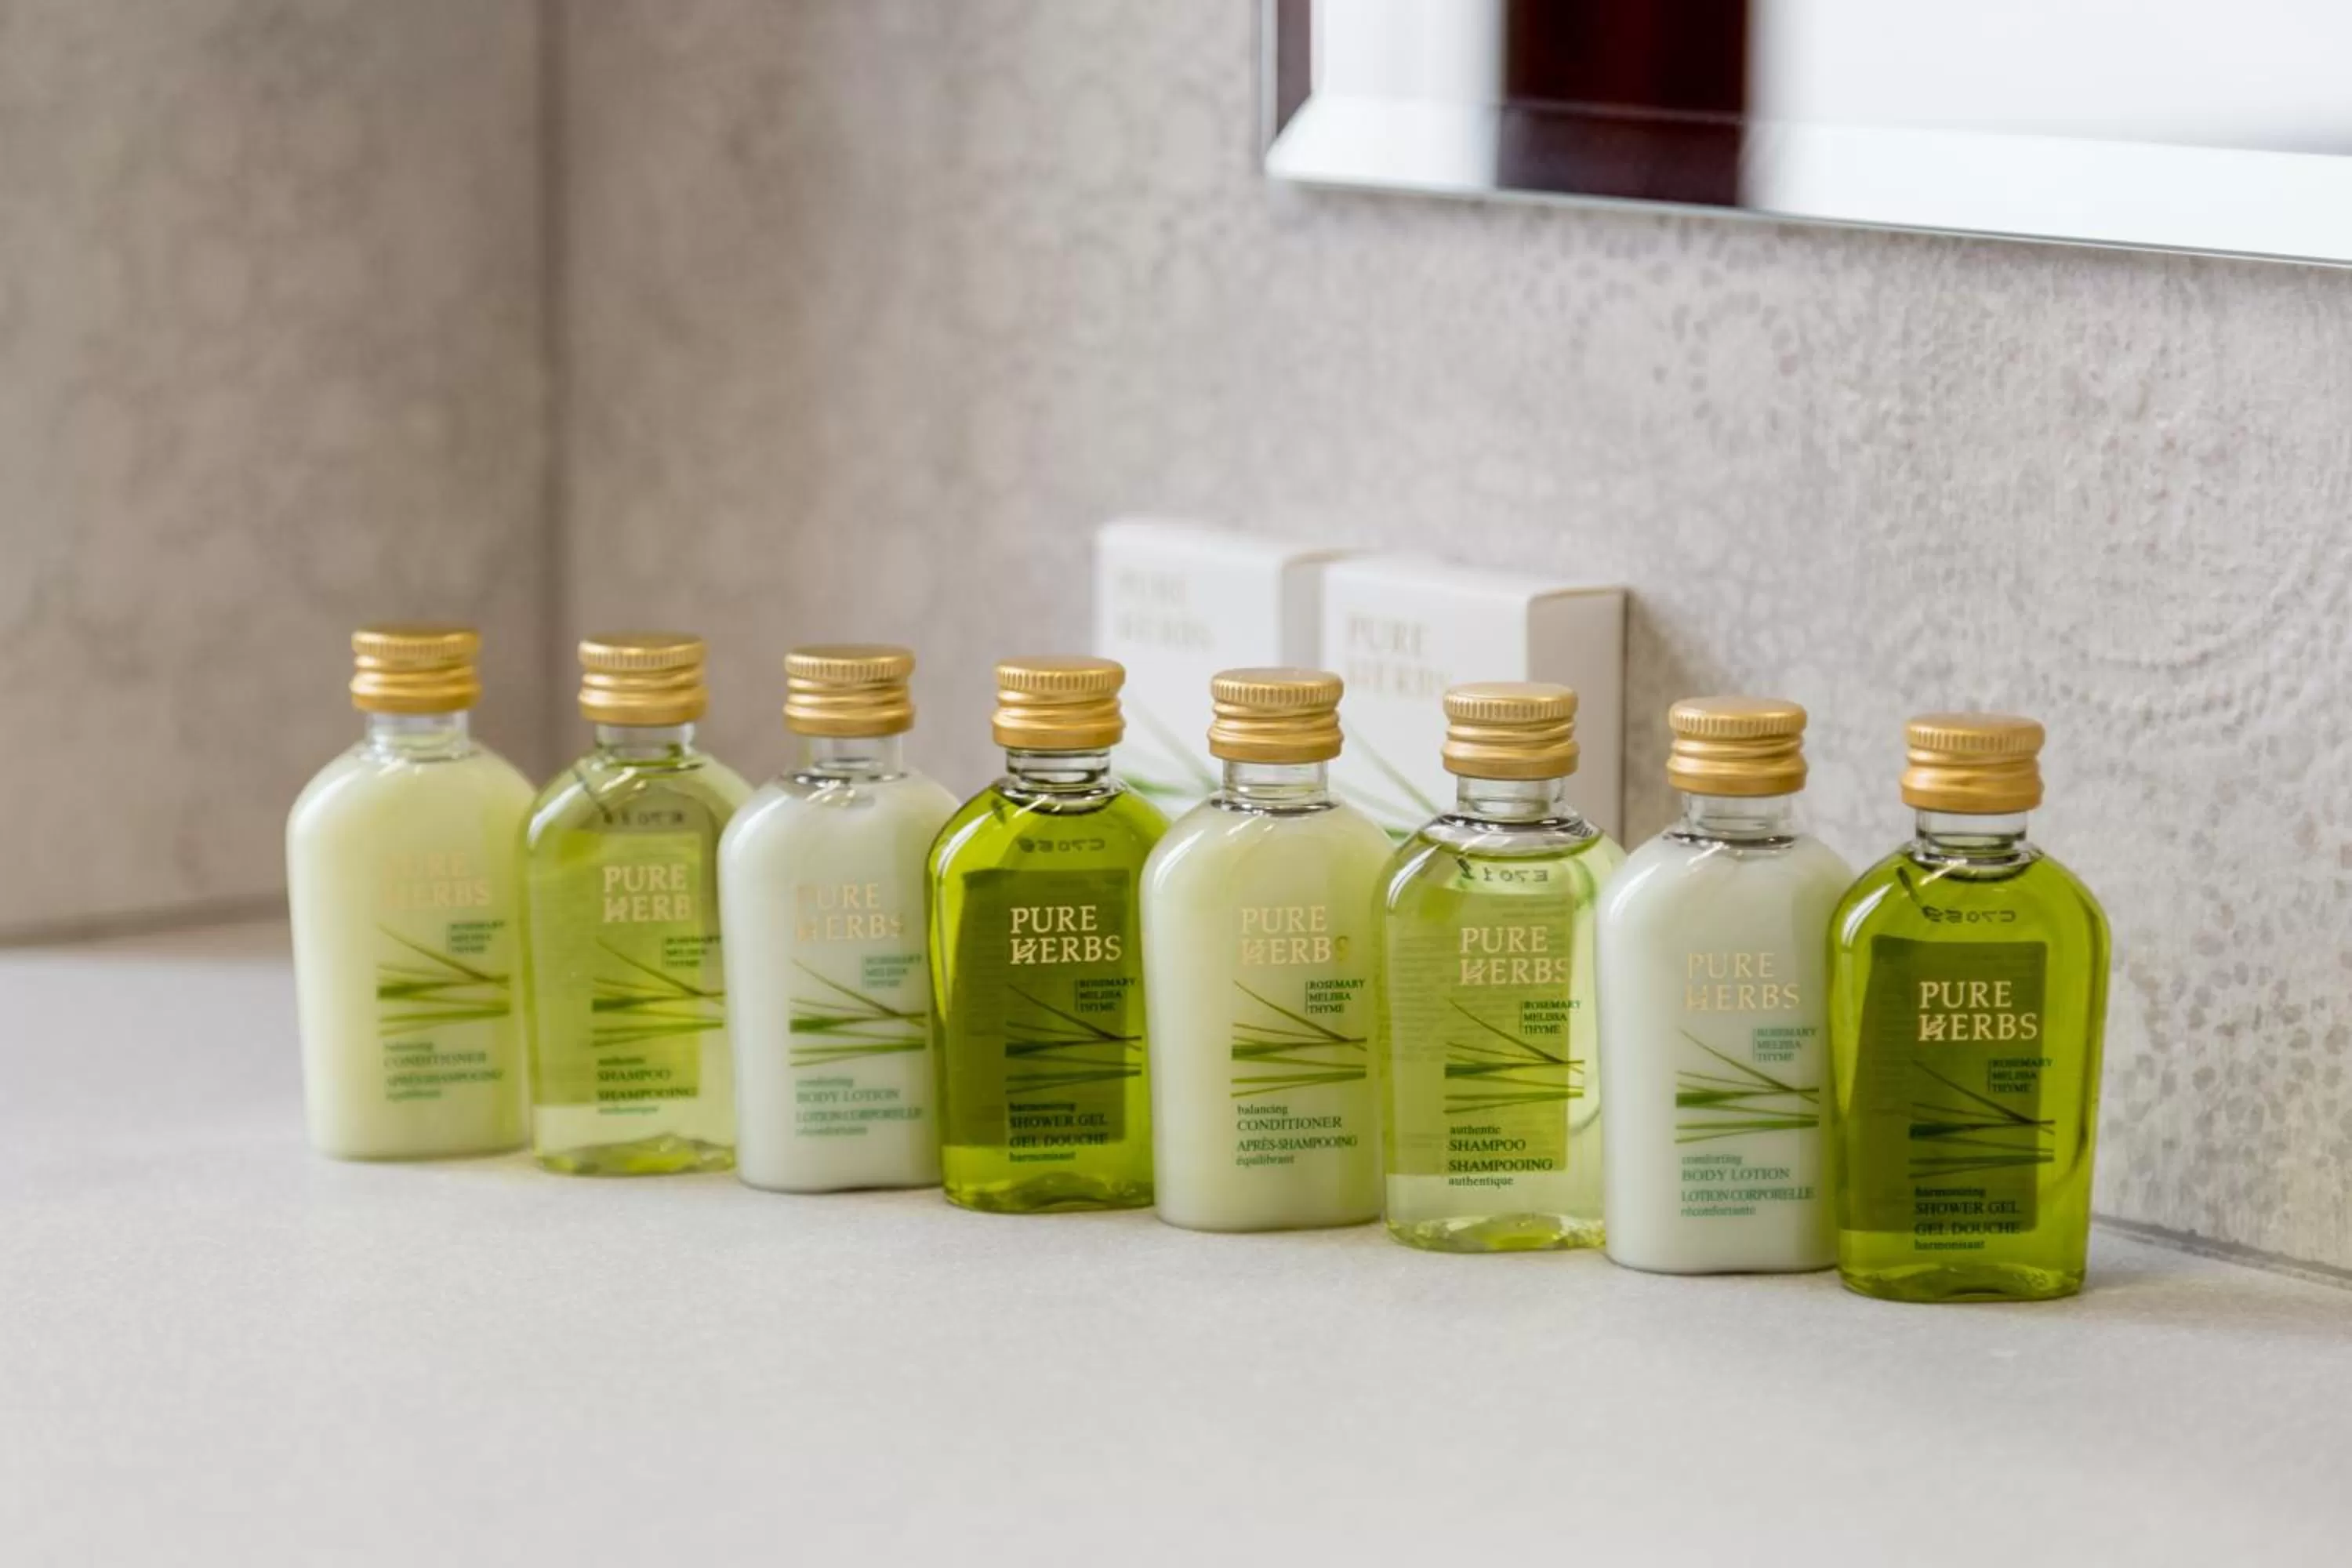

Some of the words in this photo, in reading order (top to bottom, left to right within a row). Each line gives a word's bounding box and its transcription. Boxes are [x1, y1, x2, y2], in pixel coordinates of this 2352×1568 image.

[602, 864, 688, 893] PURE
[602, 894, 692, 924] HERB
[1010, 906, 1098, 934] PURE
[1240, 906, 1327, 935] PURE
[1459, 926, 1548, 954] PURE
[1010, 935, 1123, 965] HERBS
[1240, 935, 1349, 966] HERBS
[1459, 956, 1569, 986] HERBS
[1686, 953, 1776, 979] PURE
[1308, 979, 1366, 989] ROSEMARY
[1686, 982, 1802, 1011] HERBS
[1918, 981, 2013, 1009] PURE
[1308, 1004, 1345, 1014] THYME
[1523, 1000, 1581, 1010] ROSEMARY
[1523, 1012, 1568, 1022] MELISSA
[1523, 1025, 1562, 1035] THYME
[1918, 1012, 2038, 1042] HERBS
[1236, 1104, 1288, 1116] balancing
[1236, 1116, 1343, 1131] CONDITIONER
[1450, 1126, 1501, 1135] authentic
[1450, 1138, 1527, 1152] SHAMPOO
[1449, 1157, 1554, 1172] SHAMPOOING
[1682, 1168, 1726, 1181] BODY
[1730, 1167, 1791, 1181] LOTION
[1449, 1177, 1515, 1189] authentique
[1915, 1200, 1984, 1214] SHOWER
[1988, 1199, 2021, 1214] GEL
[1914, 1222, 1945, 1236] GEL
[1951, 1220, 2022, 1235] DOUCHE
